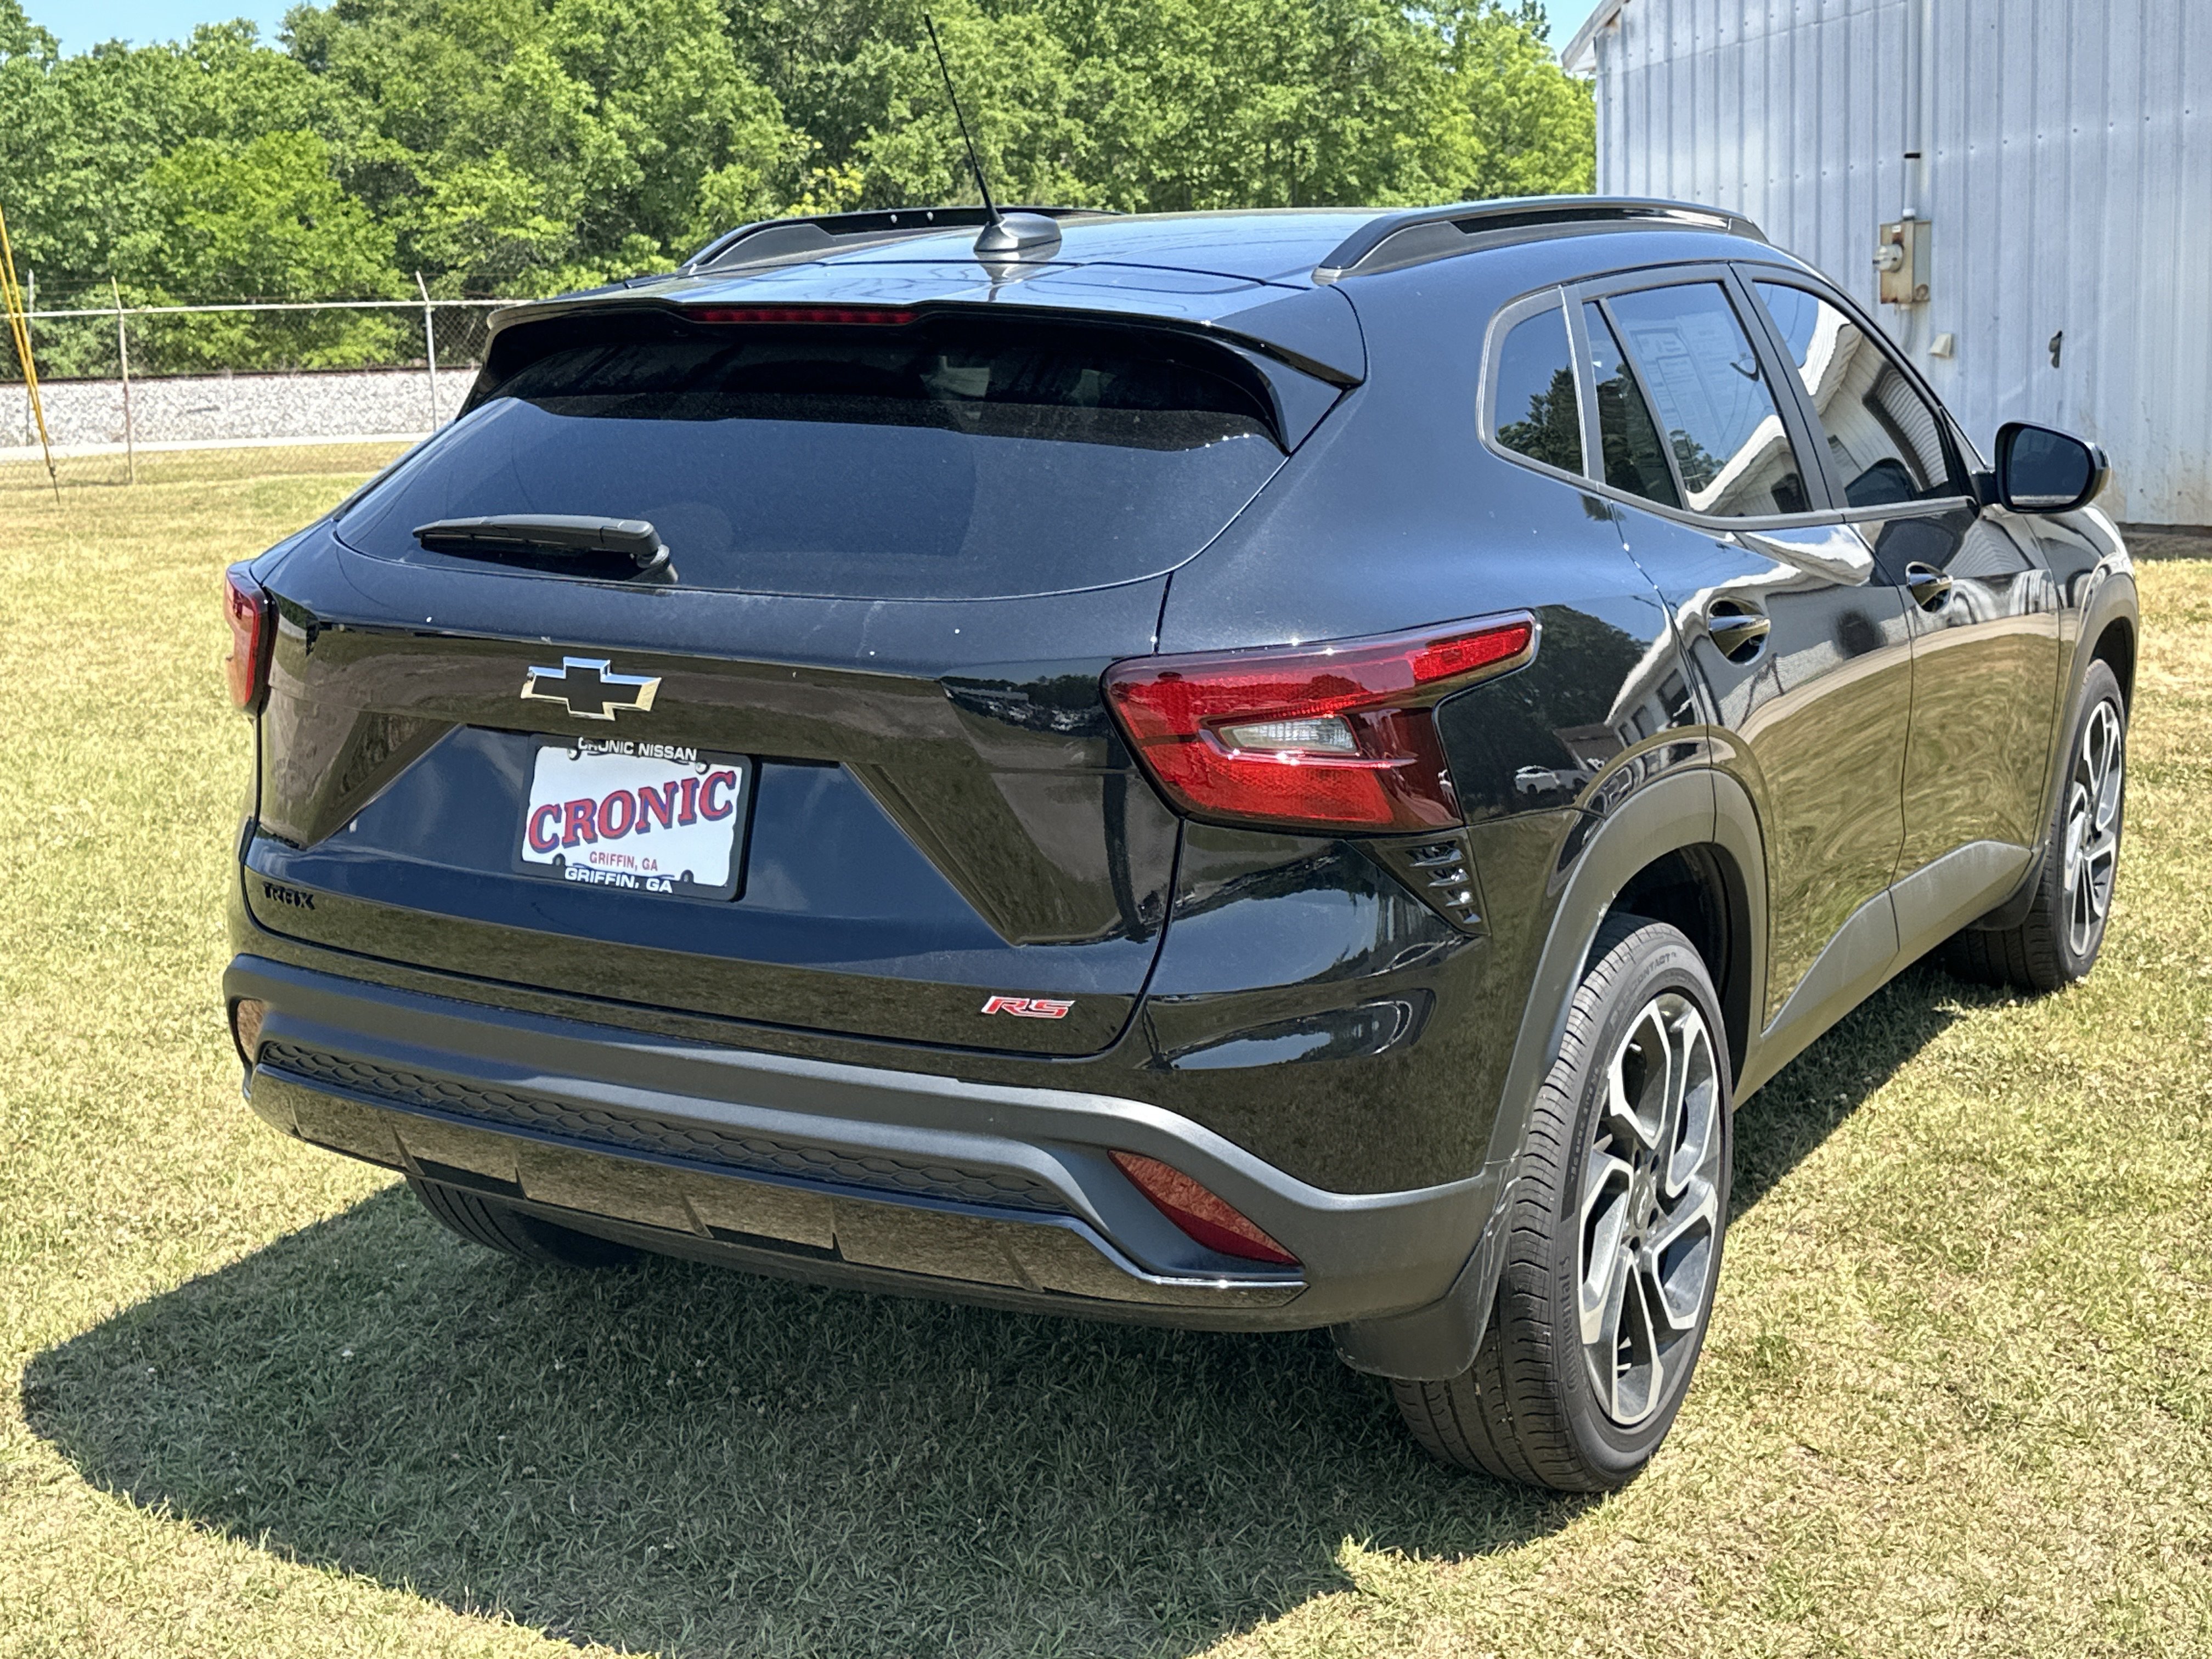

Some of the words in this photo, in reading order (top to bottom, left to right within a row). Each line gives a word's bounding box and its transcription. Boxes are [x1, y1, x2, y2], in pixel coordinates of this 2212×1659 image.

[639, 743, 697, 761] NISSAN
[528, 770, 736, 854] CRONIC
[589, 851, 637, 872] GRIFFIN,
[642, 857, 658, 871] GA
[565, 867, 640, 889] GRIFFIN,
[646, 878, 673, 893] GA
[981, 996, 1076, 1019] RS
